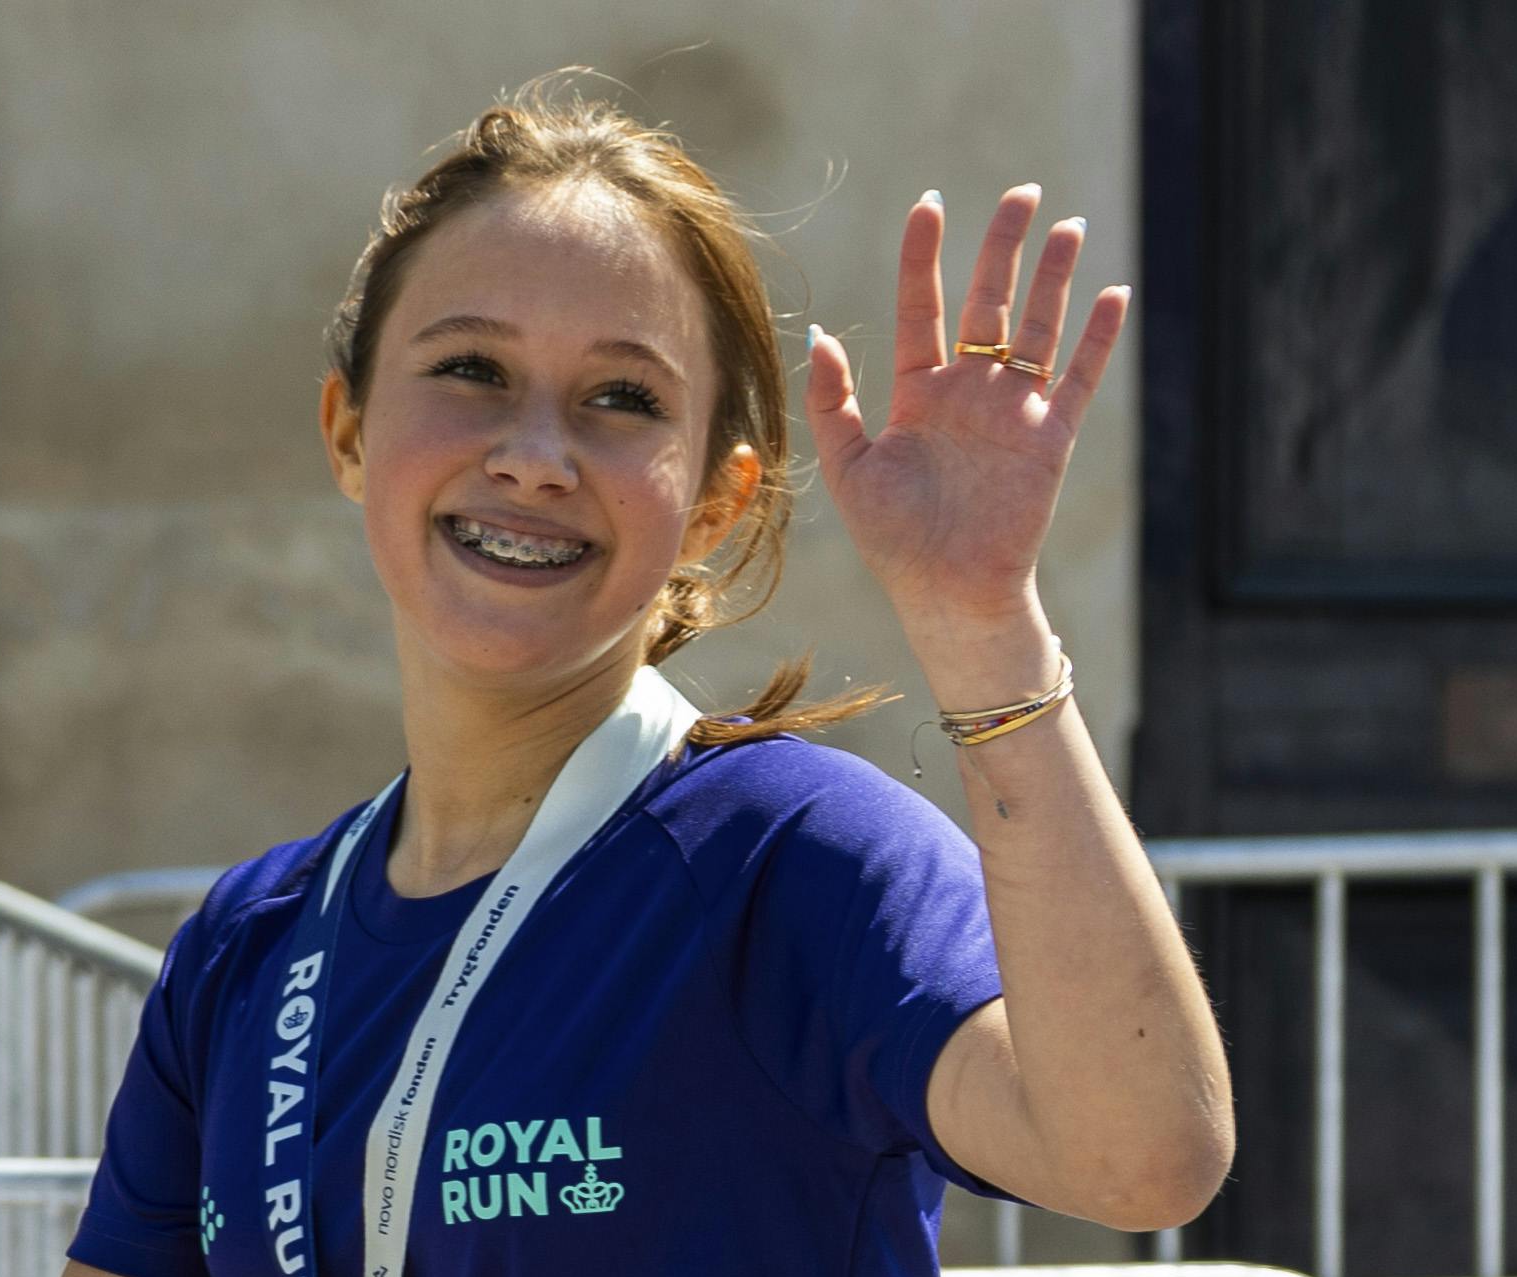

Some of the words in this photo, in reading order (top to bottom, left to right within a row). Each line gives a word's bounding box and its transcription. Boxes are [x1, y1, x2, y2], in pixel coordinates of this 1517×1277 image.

[441, 885, 520, 1008] TrygFonden
[265, 950, 324, 1167] ROYAL
[401, 1037, 437, 1106] fonden
[384, 1110, 409, 1181] nordisk
[443, 1117, 622, 1173] ROYAL
[378, 1186, 394, 1235] novo
[442, 1172, 549, 1225] RUN
